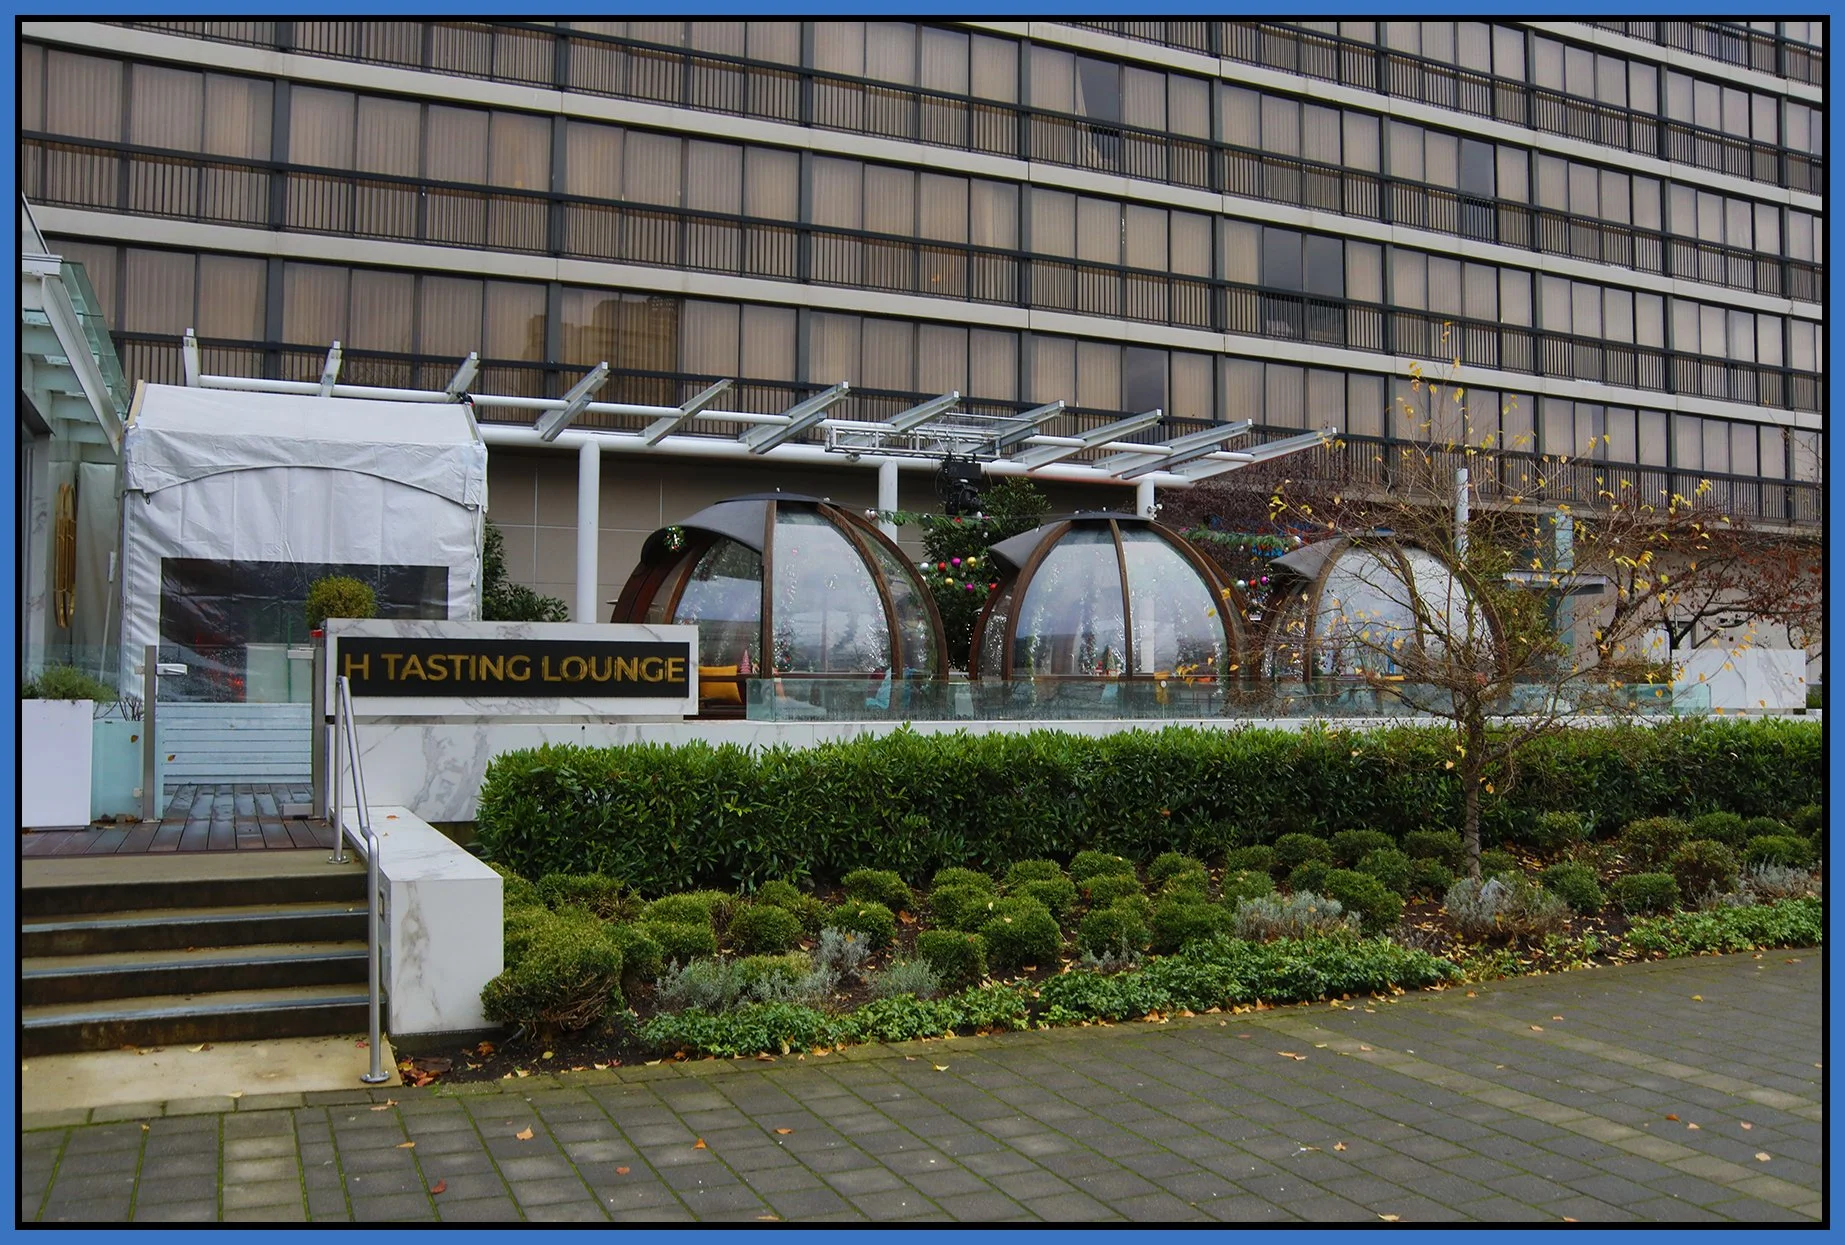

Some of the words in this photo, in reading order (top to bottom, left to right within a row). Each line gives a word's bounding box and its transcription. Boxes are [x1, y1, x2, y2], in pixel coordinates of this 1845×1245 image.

[344, 653, 370, 681] H
[380, 653, 531, 682] TASTING
[541, 654, 686, 683] LOUNGE
